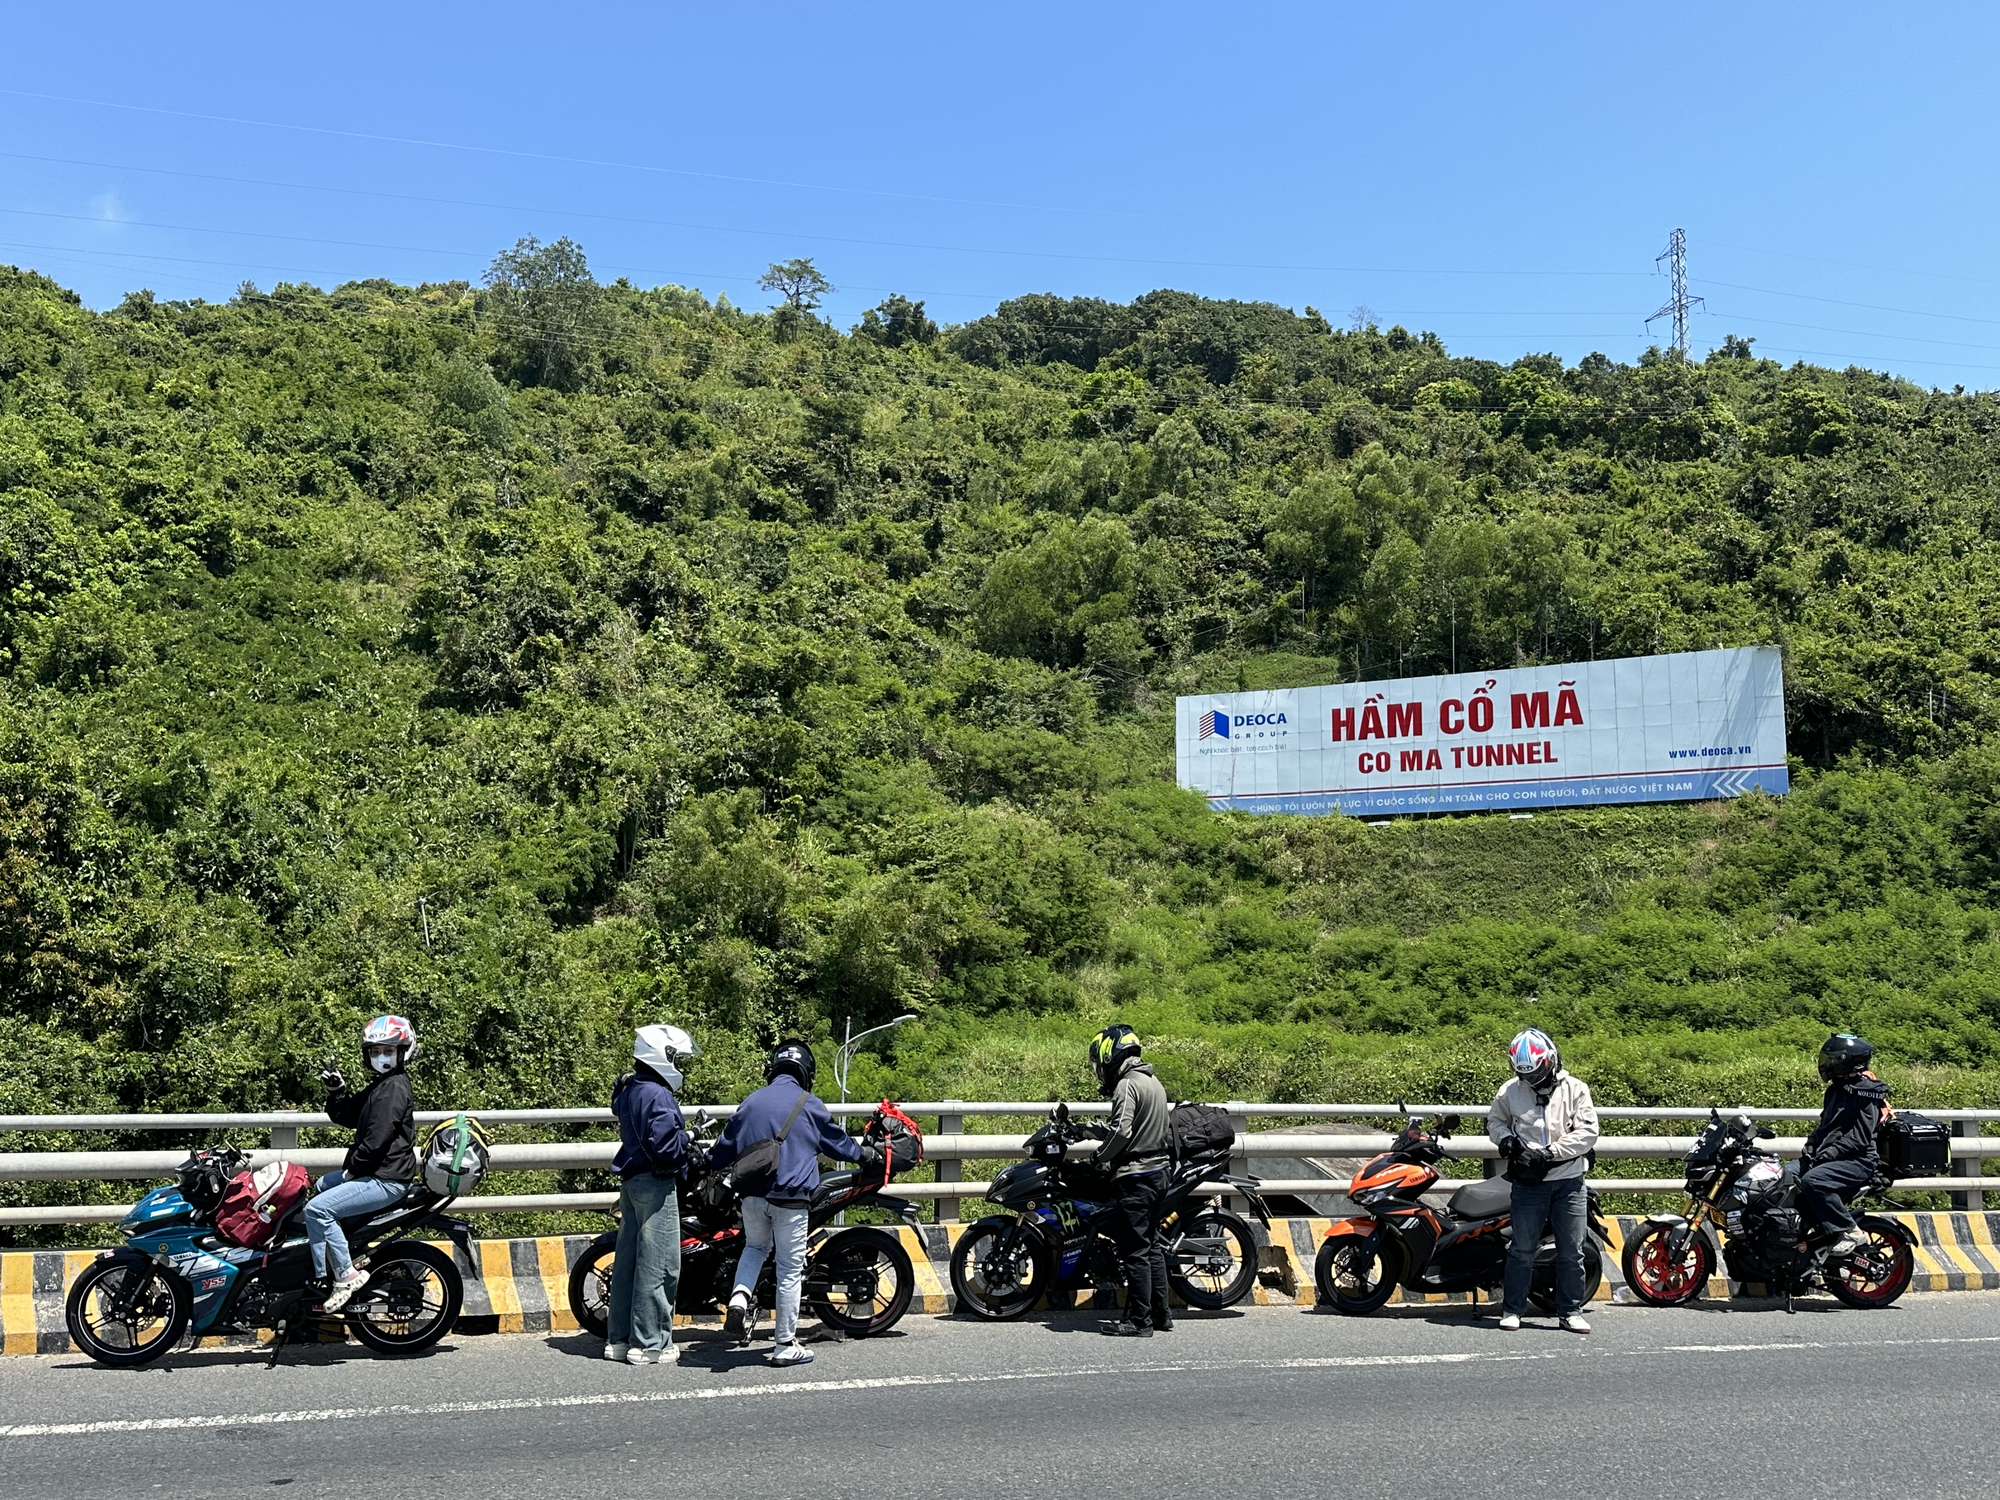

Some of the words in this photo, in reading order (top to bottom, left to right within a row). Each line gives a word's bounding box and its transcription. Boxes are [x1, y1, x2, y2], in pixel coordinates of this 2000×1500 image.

[1332, 693, 1423, 742] HẦM
[1439, 679, 1497, 735] CỔ
[1510, 680, 1584, 729] MÃ
[1234, 712, 1288, 727] DEOCA
[1234, 731, 1288, 740] GROUP
[1358, 751, 1391, 774] CO
[1400, 749, 1442, 772] MA
[1450, 741, 1558, 769] TUNNEL
[1669, 745, 1751, 759] www.deoca.vn
[1250, 801, 1282, 813] CHÚNG
[1284, 801, 1299, 811] TÔI
[1301, 800, 1325, 811] LUÔN
[1343, 800, 1361, 809] LỰC
[1364, 798, 1374, 807] VÌ
[1376, 796, 1405, 808] CUỘC
[1408, 793, 1435, 805] SỐNG
[1438, 795, 1453, 804] AN
[1455, 791, 1483, 803] TOÀN
[1486, 792, 1510, 801] CHO
[1513, 790, 1537, 799] CON
[1541, 787, 1578, 798] NGƯỜI,
[1581, 784, 1601, 796] ĐẤT
[1604, 782, 1637, 795] NƯỚC
[1640, 782, 1663, 794] VIỆT
[1666, 782, 1693, 791] NAM
[173, 1252, 192, 1260] YAMAHA
[202, 1275, 226, 1290] YSS
